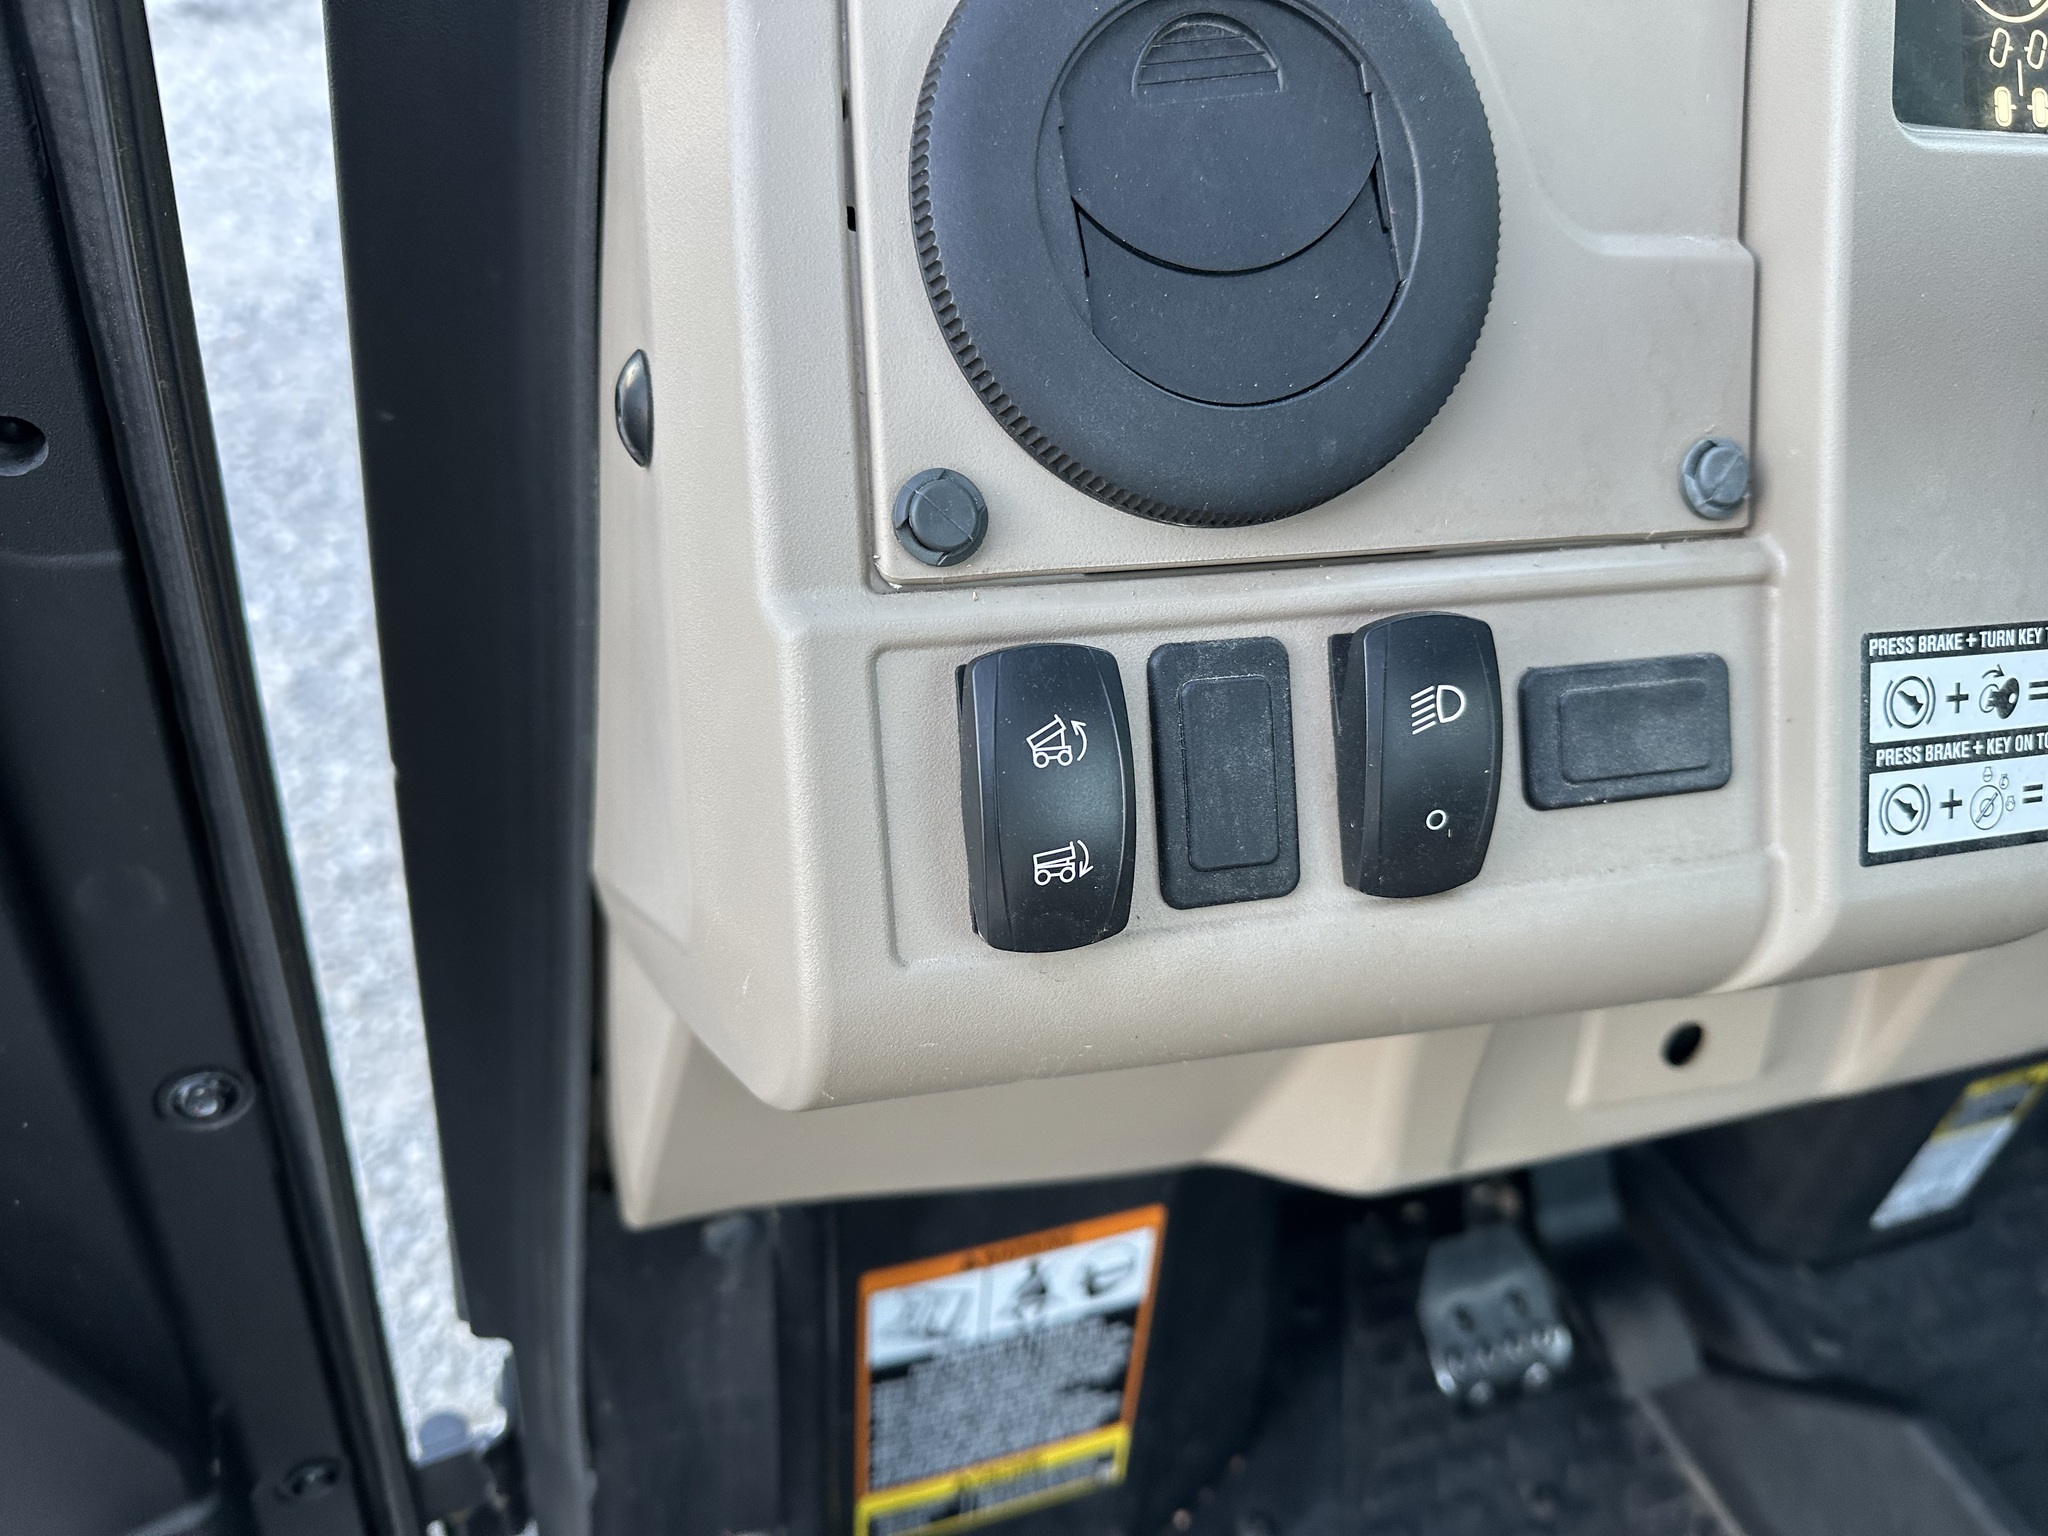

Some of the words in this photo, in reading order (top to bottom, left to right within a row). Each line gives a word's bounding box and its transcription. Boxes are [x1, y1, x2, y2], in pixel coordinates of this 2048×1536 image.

[1869, 638, 1914, 656] PRESS
[1918, 633, 1963, 653] BRAKE
[1979, 629, 2014, 648] TURN
[2018, 627, 2042, 645] KEY
[1876, 746, 1921, 767] PRESS
[1925, 741, 1970, 762] BRAKE
[1986, 736, 2011, 755] KEY
[2014, 734, 2033, 752] ON
